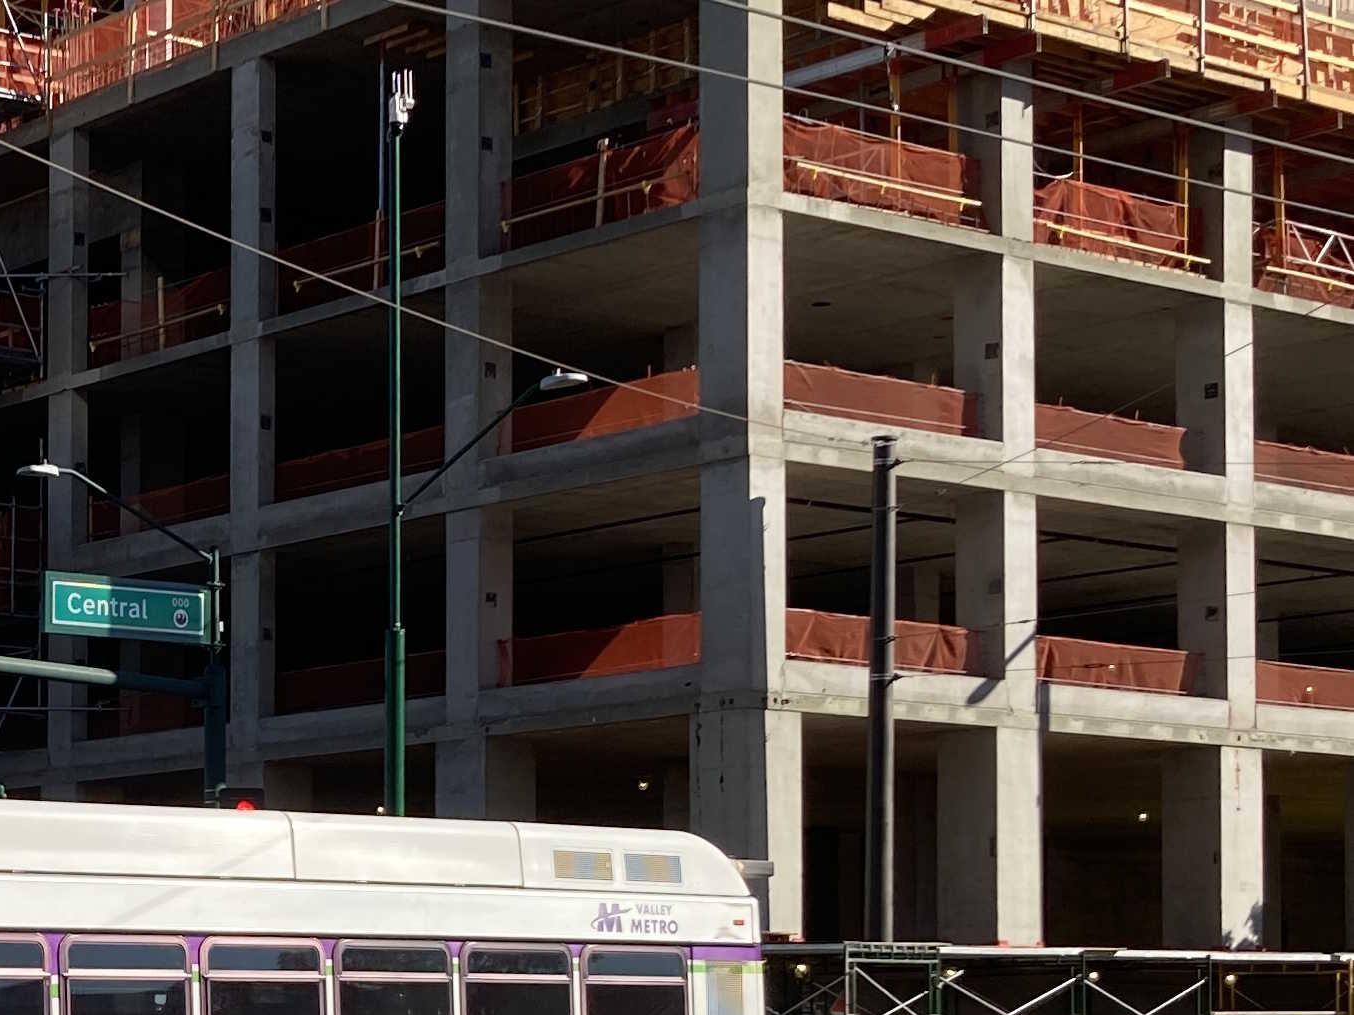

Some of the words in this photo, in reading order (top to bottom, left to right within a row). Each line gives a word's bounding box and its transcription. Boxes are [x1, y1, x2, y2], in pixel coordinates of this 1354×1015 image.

[67, 592, 148, 619] Central
[172, 598, 190, 607] 000
[636, 904, 672, 915] VALLEY
[631, 919, 678, 934] METRO
